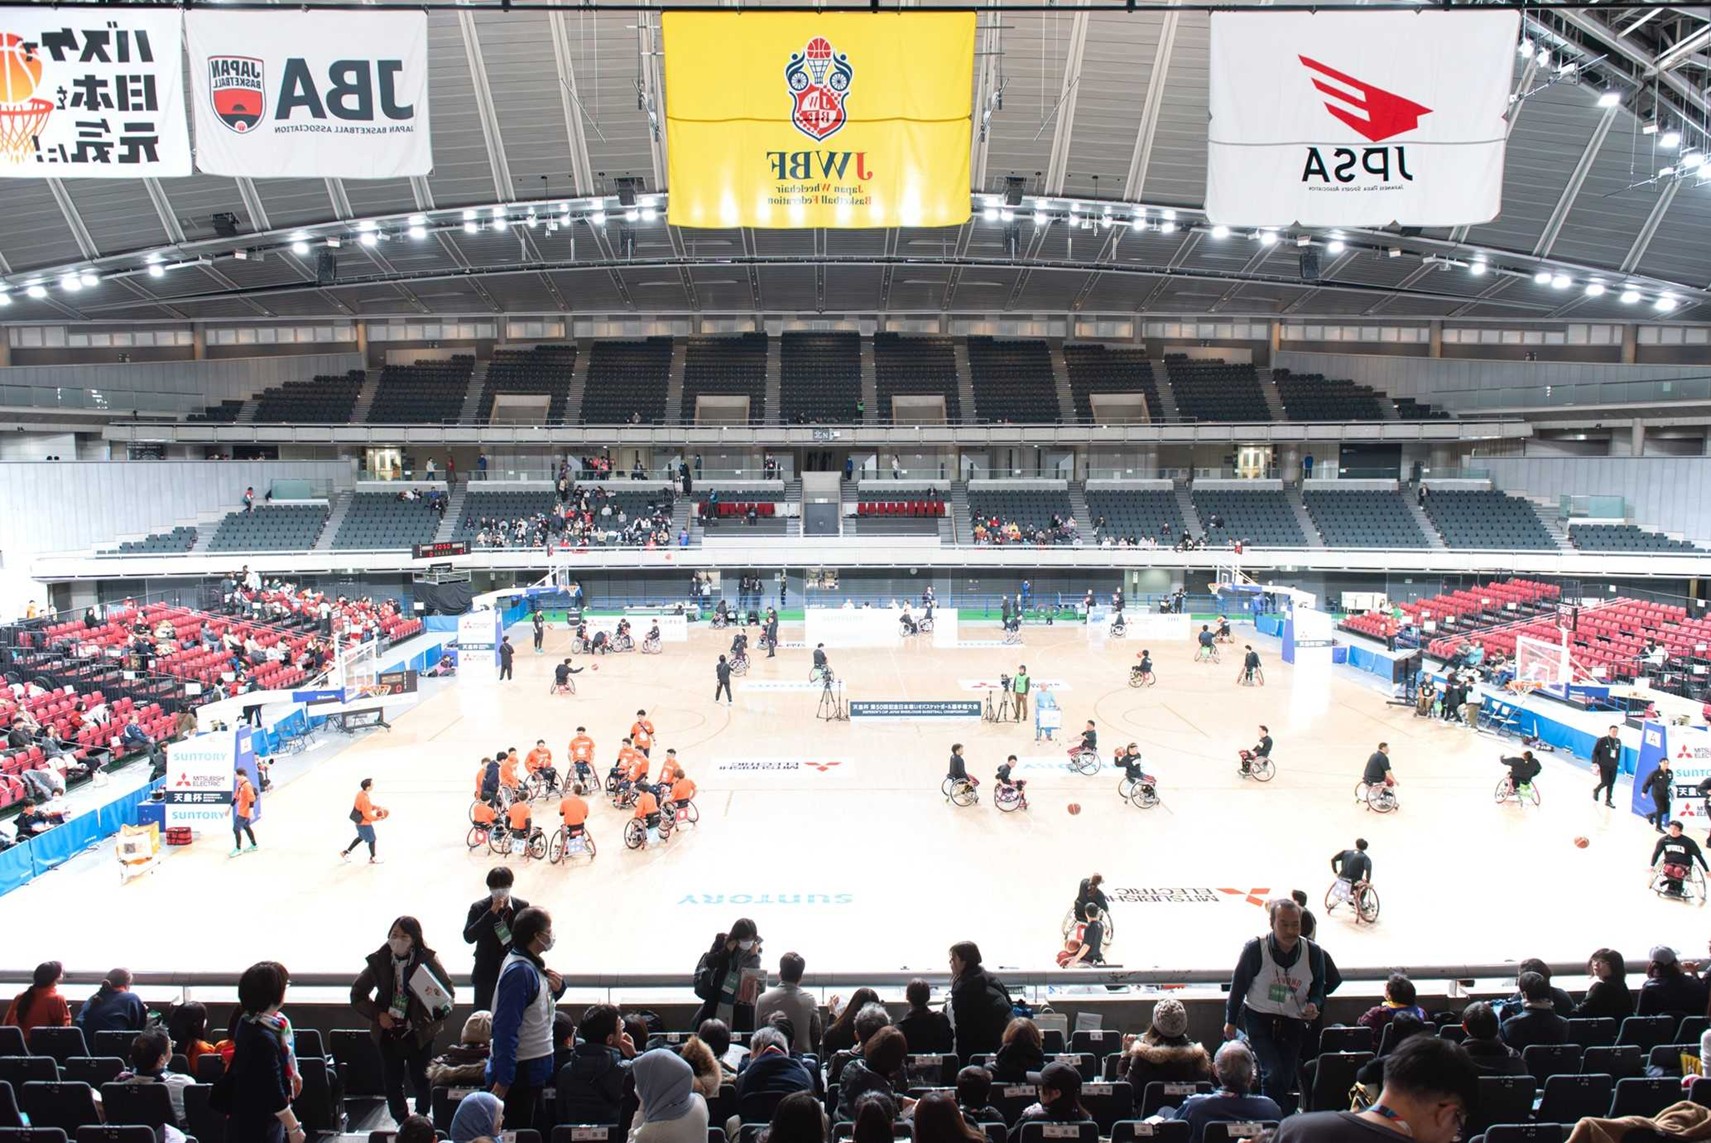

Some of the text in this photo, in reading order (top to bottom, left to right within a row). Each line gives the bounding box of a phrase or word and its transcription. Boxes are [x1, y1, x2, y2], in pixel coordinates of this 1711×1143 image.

[1559, 614, 1574, 630] 24
[173, 752, 227, 761] SUNTORY
[173, 793, 203, 803] 天皇杯
[171, 811, 225, 820] SUNTORY
[677, 893, 854, 905] SUNTORY
